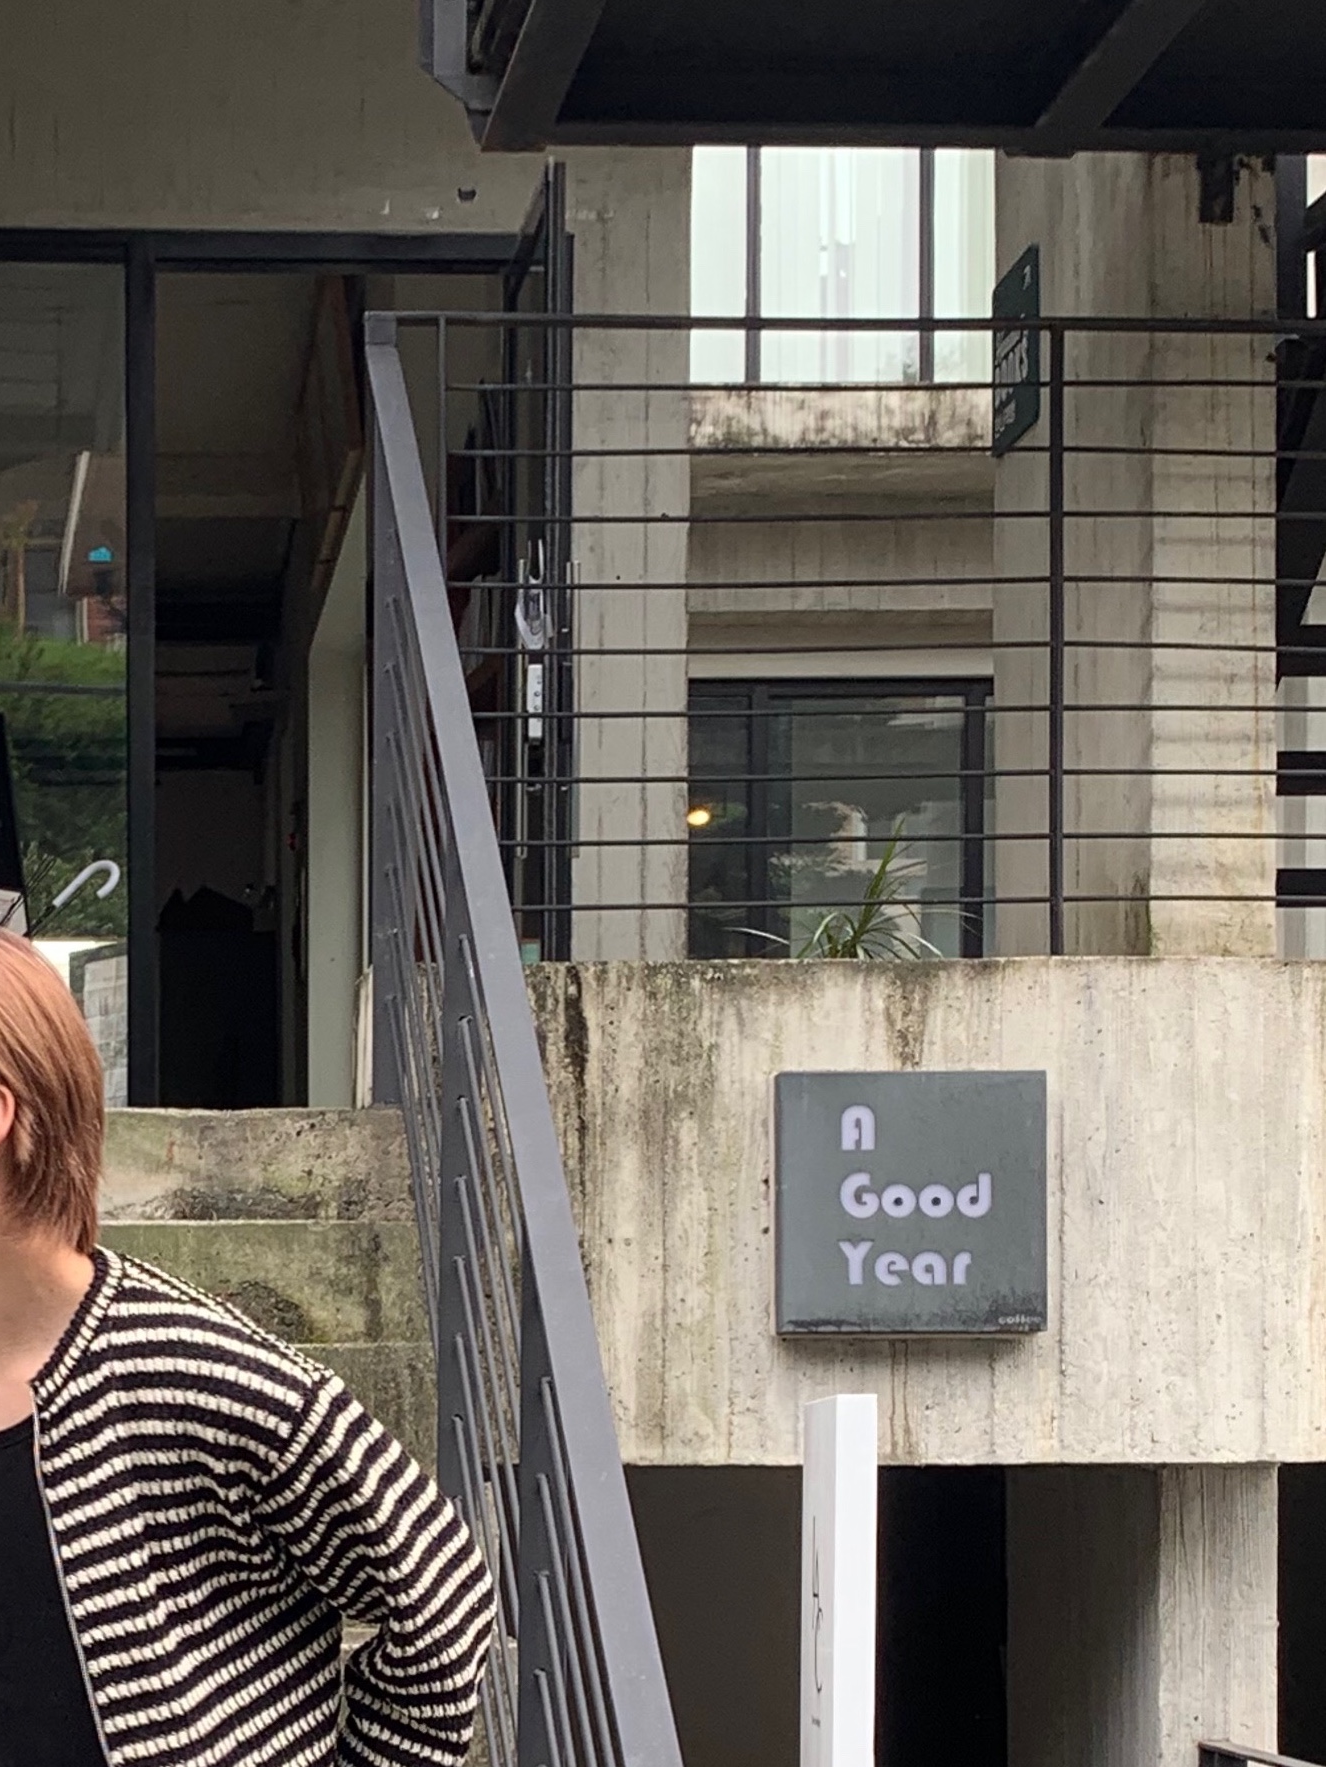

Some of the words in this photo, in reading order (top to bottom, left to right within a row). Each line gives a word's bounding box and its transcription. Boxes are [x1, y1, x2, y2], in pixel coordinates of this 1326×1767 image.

[841, 1105, 875, 1150] A
[840, 1172, 992, 1219] Good
[838, 1241, 972, 1286] Year
